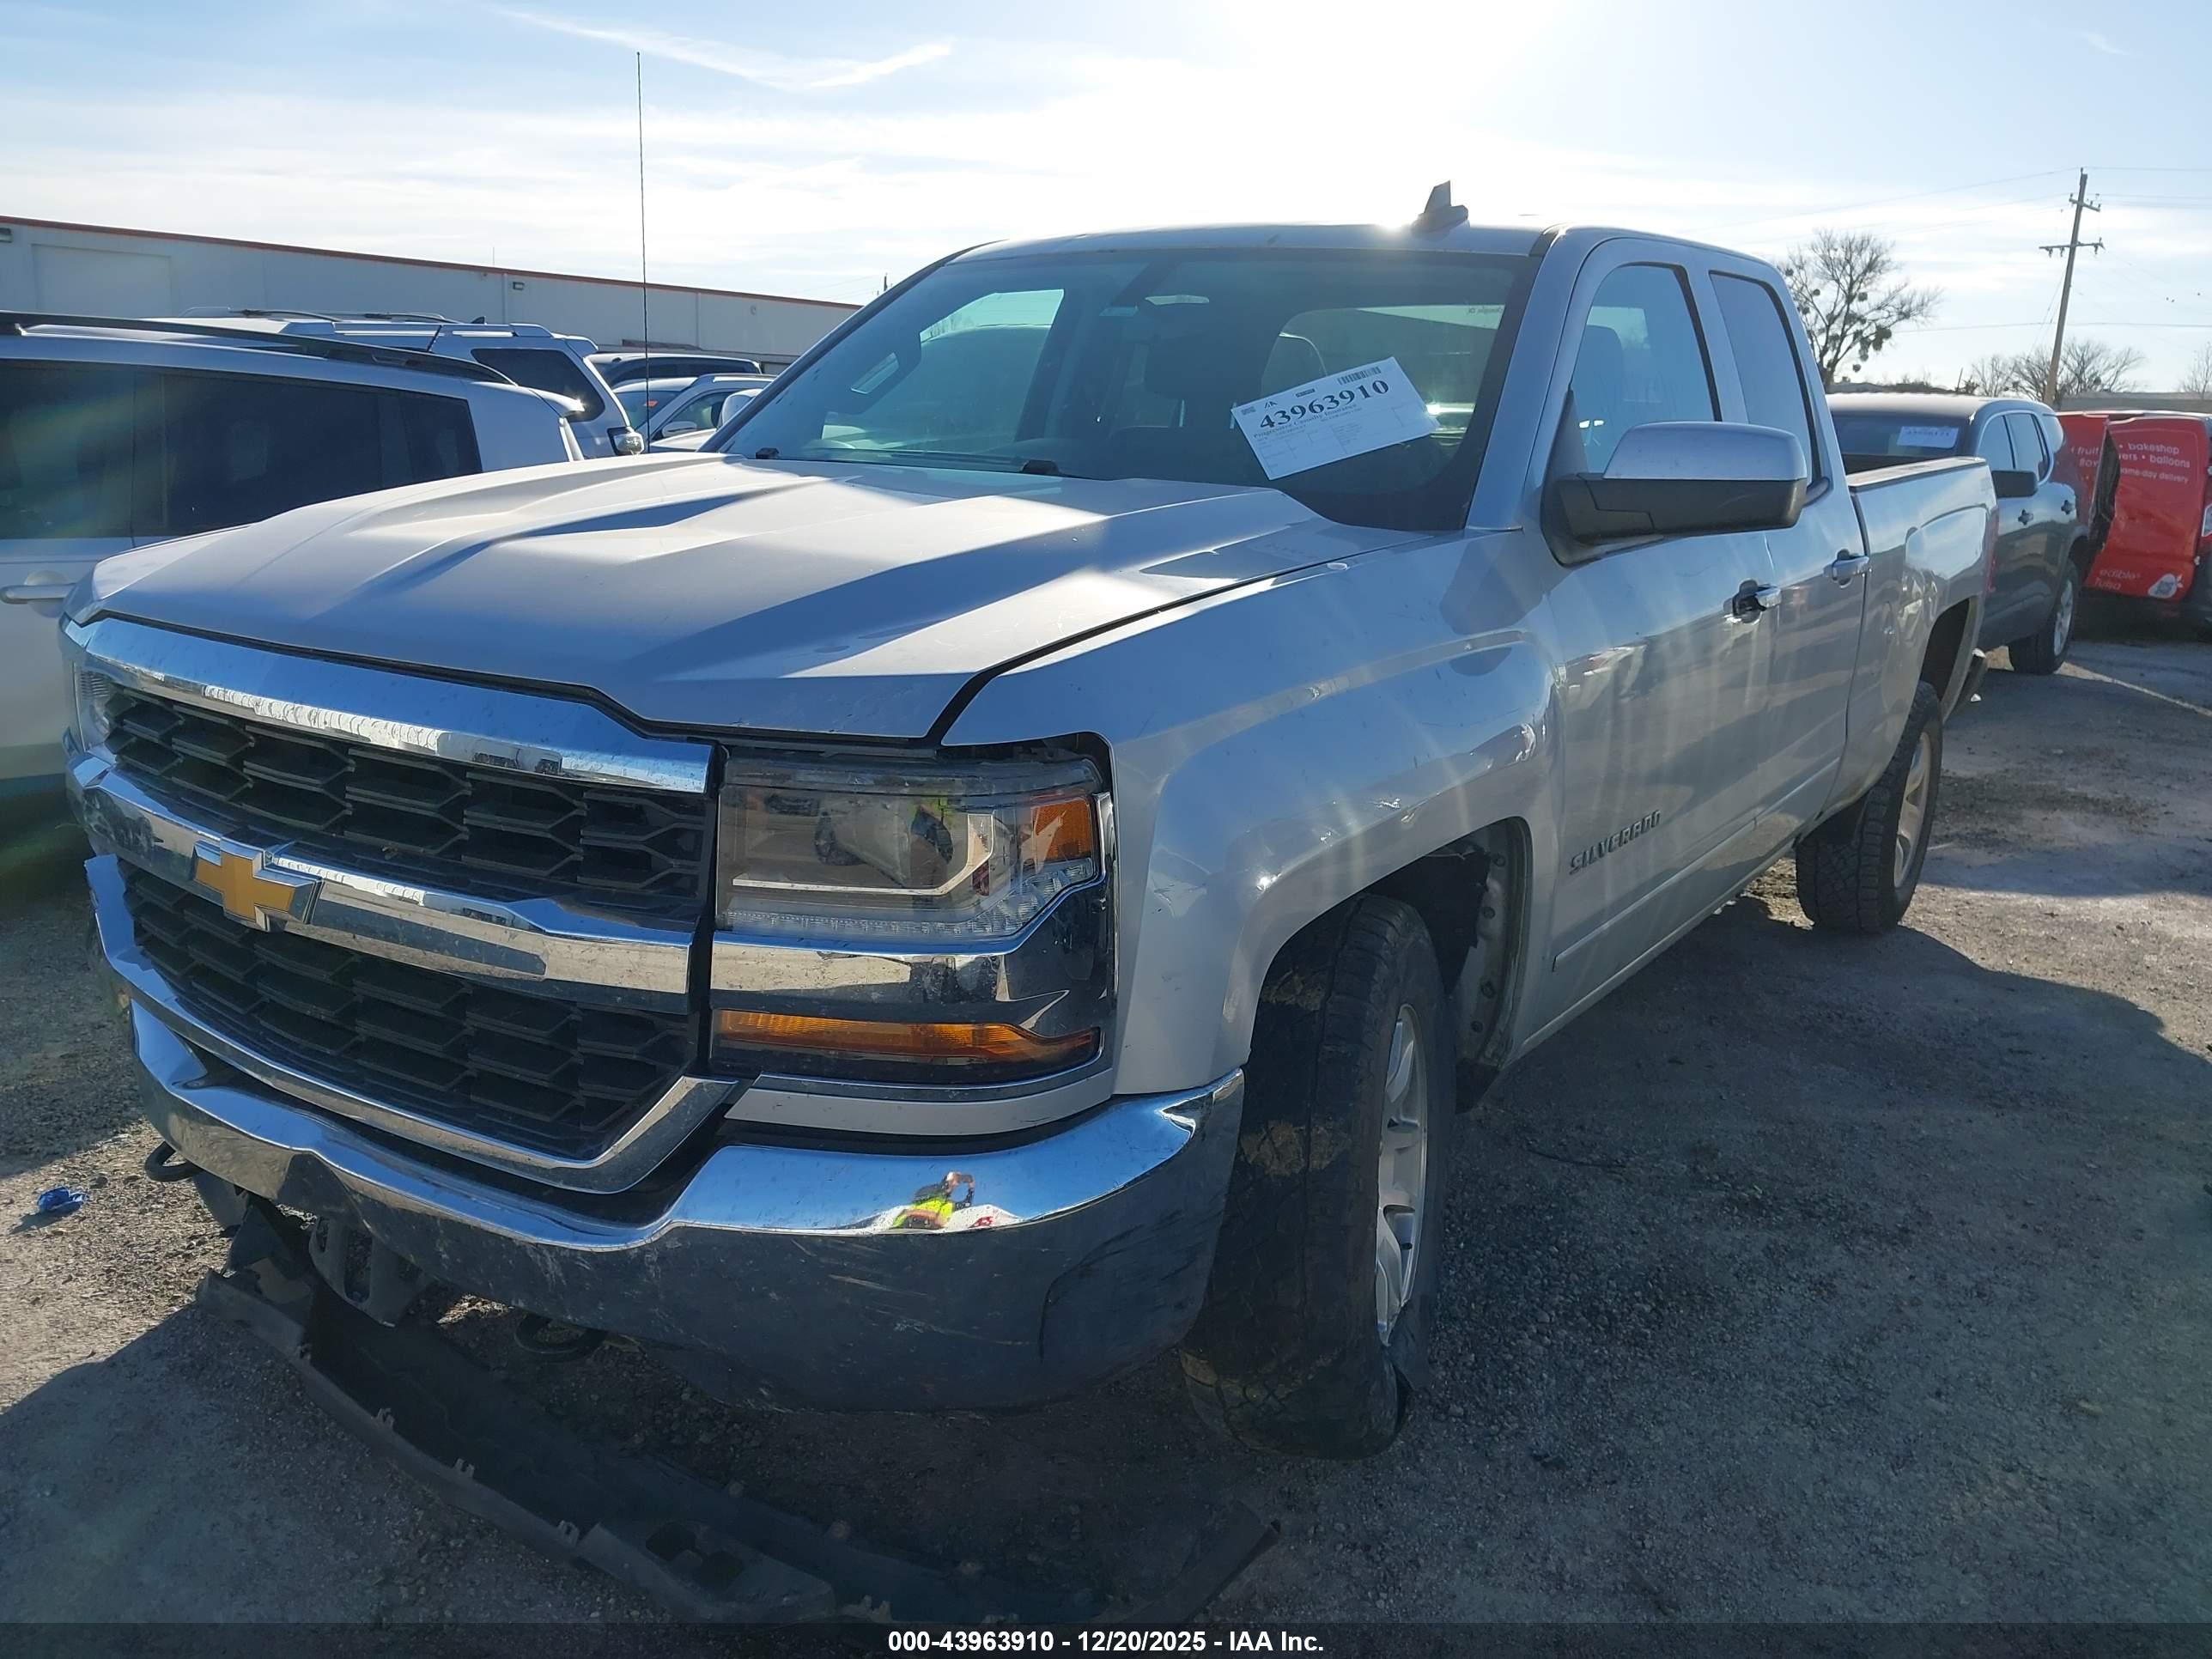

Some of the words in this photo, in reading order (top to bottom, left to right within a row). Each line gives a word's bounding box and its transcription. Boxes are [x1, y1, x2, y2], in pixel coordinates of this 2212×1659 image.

[1260, 380, 1389, 428] 43963910
[2128, 442, 2179, 454] bakeshop
[2149, 455, 2190, 468] balloons
[2159, 471, 2189, 484] delivery
[1569, 810, 1661, 875] SILVERADO
